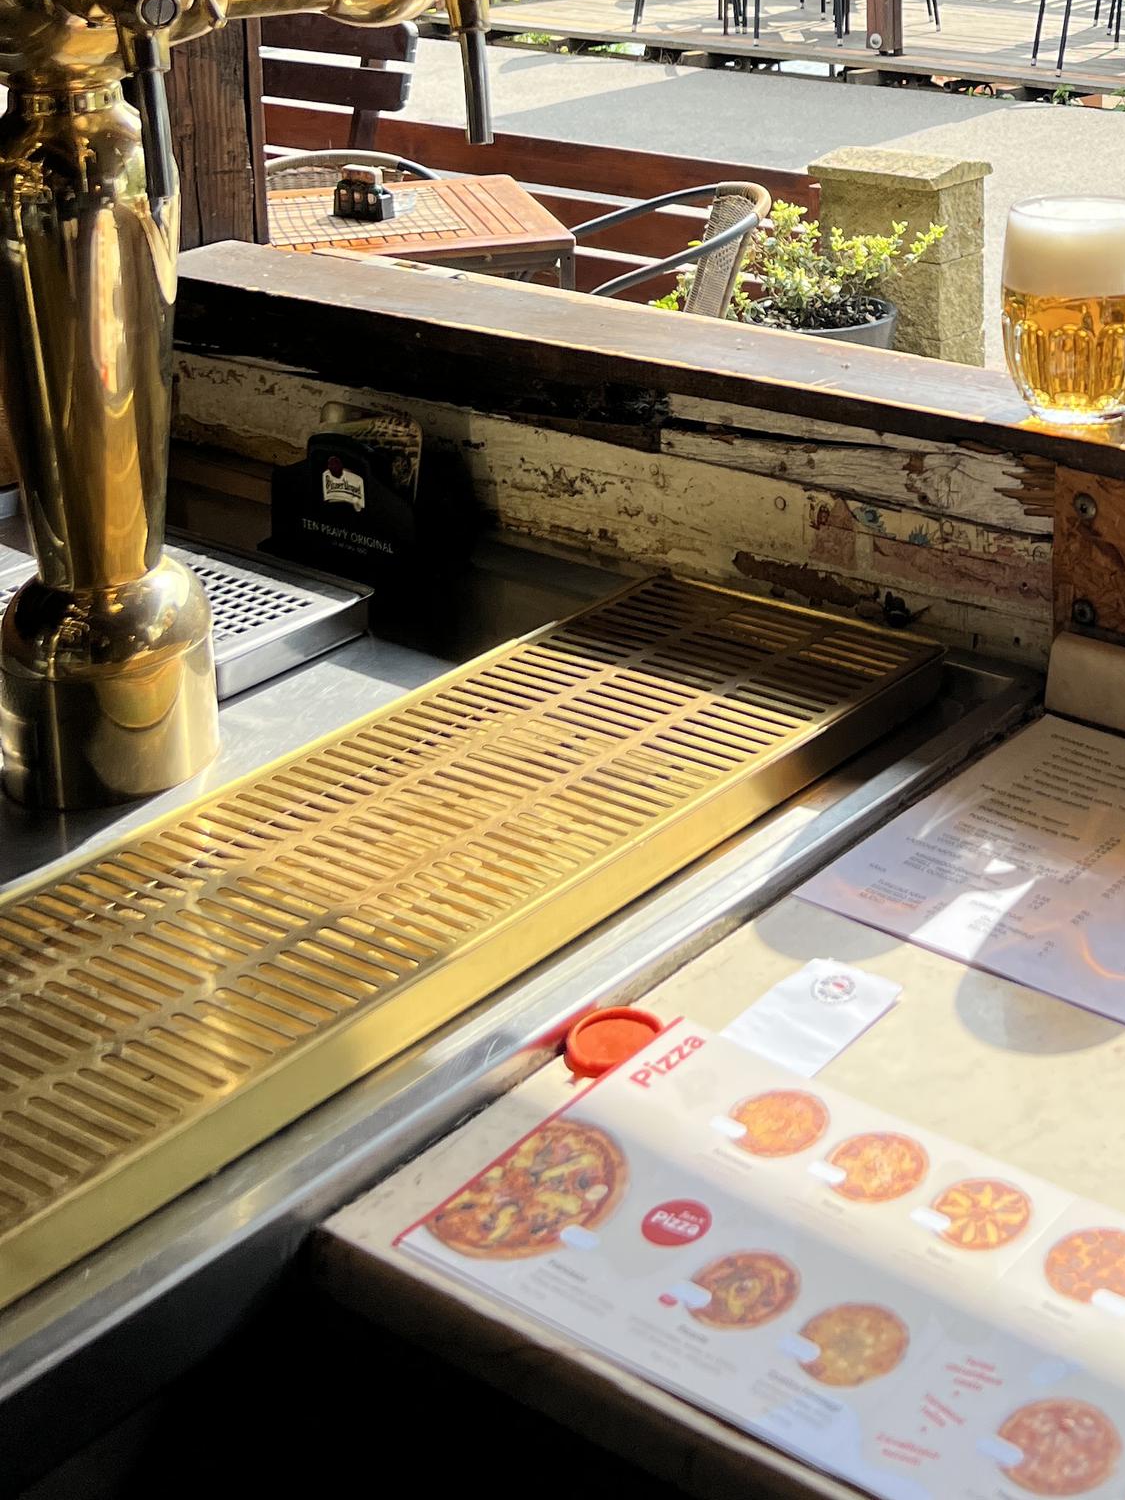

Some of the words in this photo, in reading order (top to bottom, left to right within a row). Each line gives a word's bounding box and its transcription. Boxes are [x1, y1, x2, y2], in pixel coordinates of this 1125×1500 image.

[302, 518, 319, 531] TEN
[350, 532, 394, 554] ORIGINAL
[629, 1034, 706, 1088] Pizza
[651, 1209, 700, 1237] Pizza
